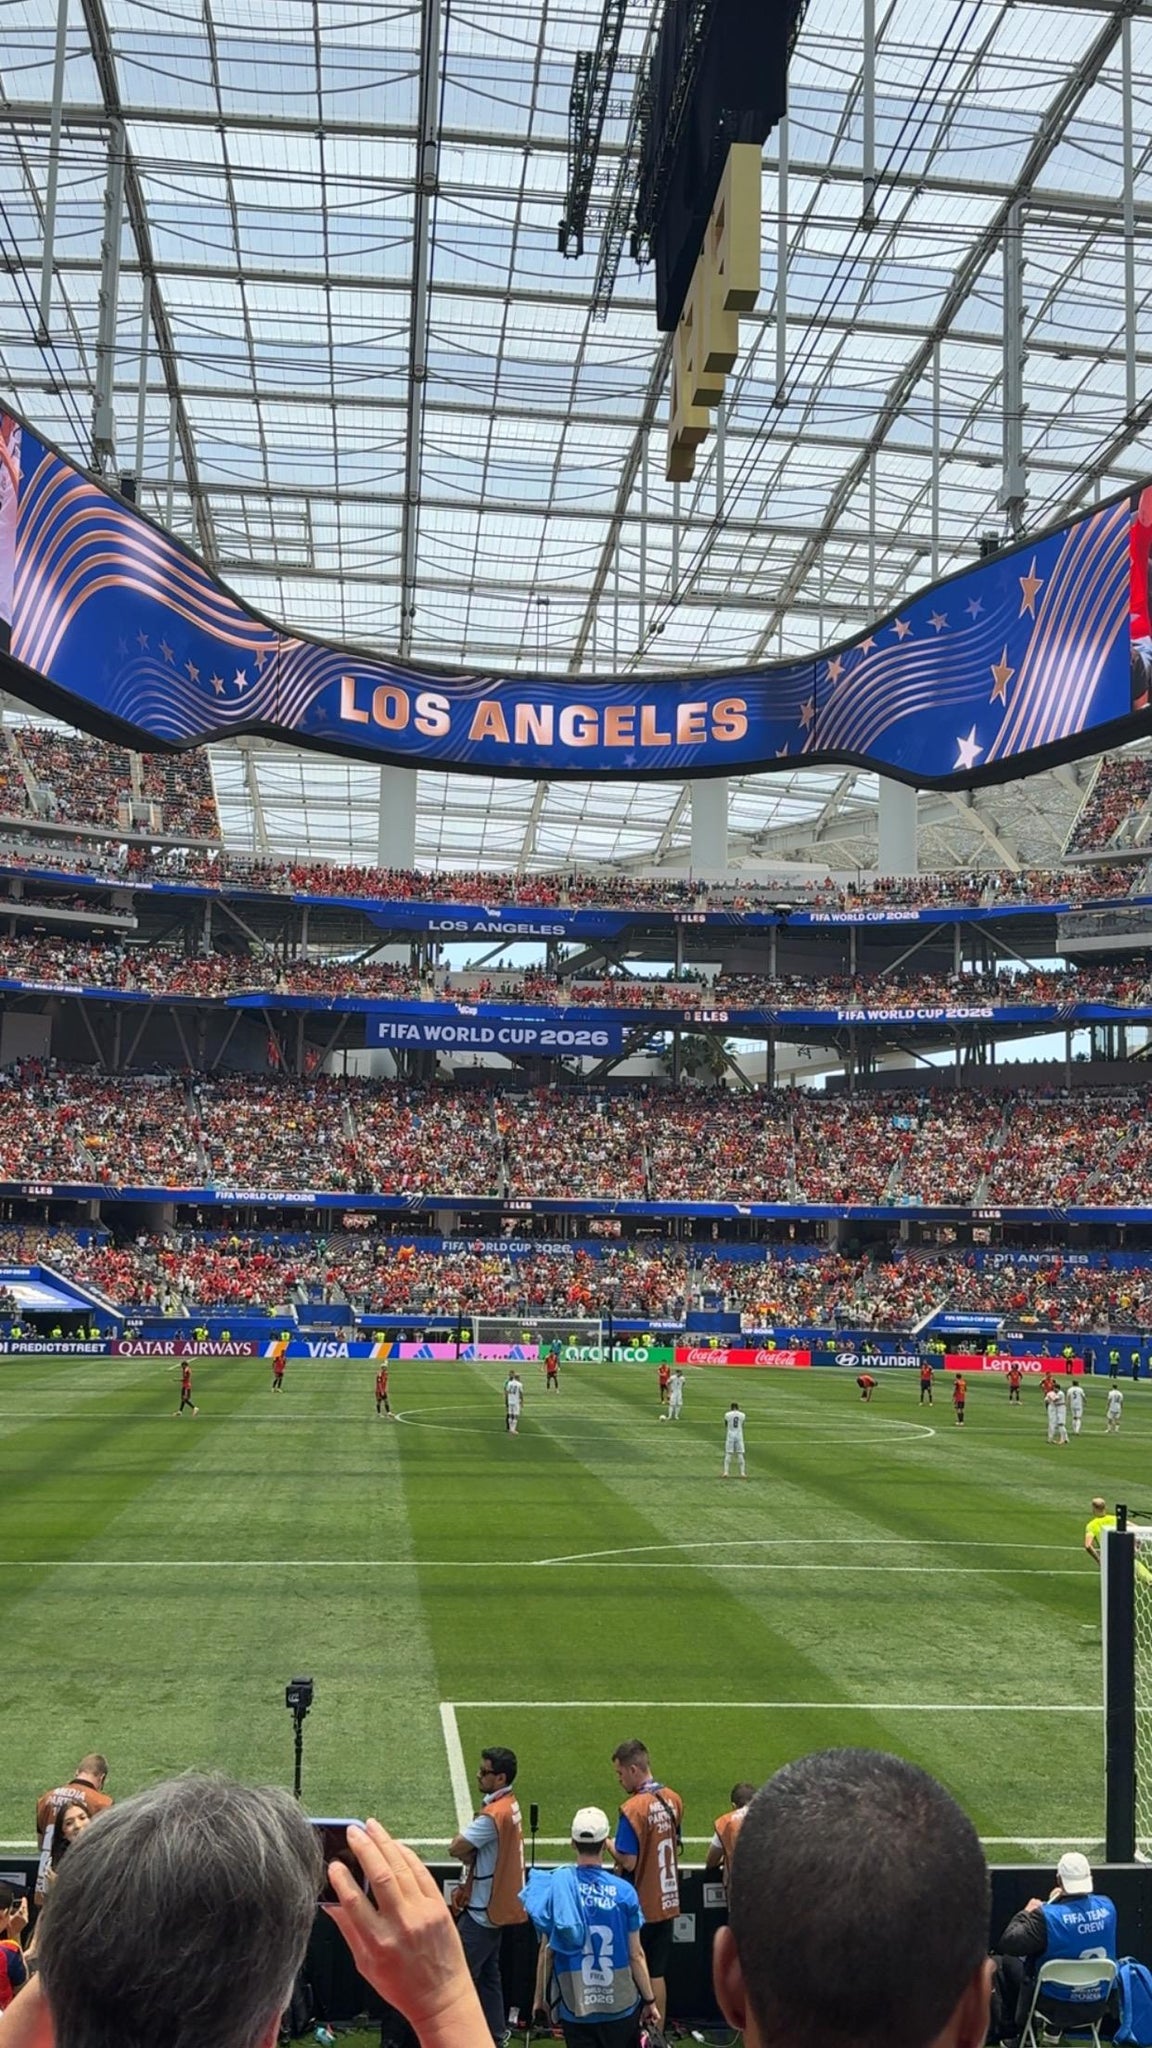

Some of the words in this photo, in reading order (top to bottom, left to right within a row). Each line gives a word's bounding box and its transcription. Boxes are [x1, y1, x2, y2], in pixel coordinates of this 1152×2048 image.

[340, 676, 451, 737] LOS
[468, 697, 748, 747] ANGELES
[810, 913, 831, 922] FIFA
[832, 912, 865, 922] WORLD
[866, 912, 885, 921] CUP
[428, 920, 468, 931] LOS
[473, 922, 566, 935] ANGELES
[837, 1010, 866, 1021] FIFA
[867, 1009, 915, 1020] WORLD
[917, 1008, 944, 1019] CUP
[945, 1008, 994, 1018] 2026
[378, 1022, 421, 1040] FIFA
[423, 1024, 495, 1043] WORLD
[498, 1028, 538, 1044] CUP
[540, 1030, 609, 1046] 2026
[215, 1191, 234, 1200] FIFA
[235, 1191, 266, 1200] WORLD
[267, 1192, 285, 1200] CUP
[442, 1241, 464, 1251] FIFA
[509, 1242, 531, 1252] CUP
[11, 1342, 106, 1353] PREDICTSTREET
[118, 1341, 175, 1357] QATAR
[181, 1341, 252, 1356] AIRWAYS
[305, 1342, 350, 1358] VISA
[565, 1346, 649, 1362] aramco
[861, 1355, 920, 1367] HYUNDAI
[982, 1357, 1042, 1372] Lenovo
[1062, 1912, 1086, 1924] FIFA
[1077, 1919, 1105, 1935] CREW
[583, 1994, 614, 2006] 2026
